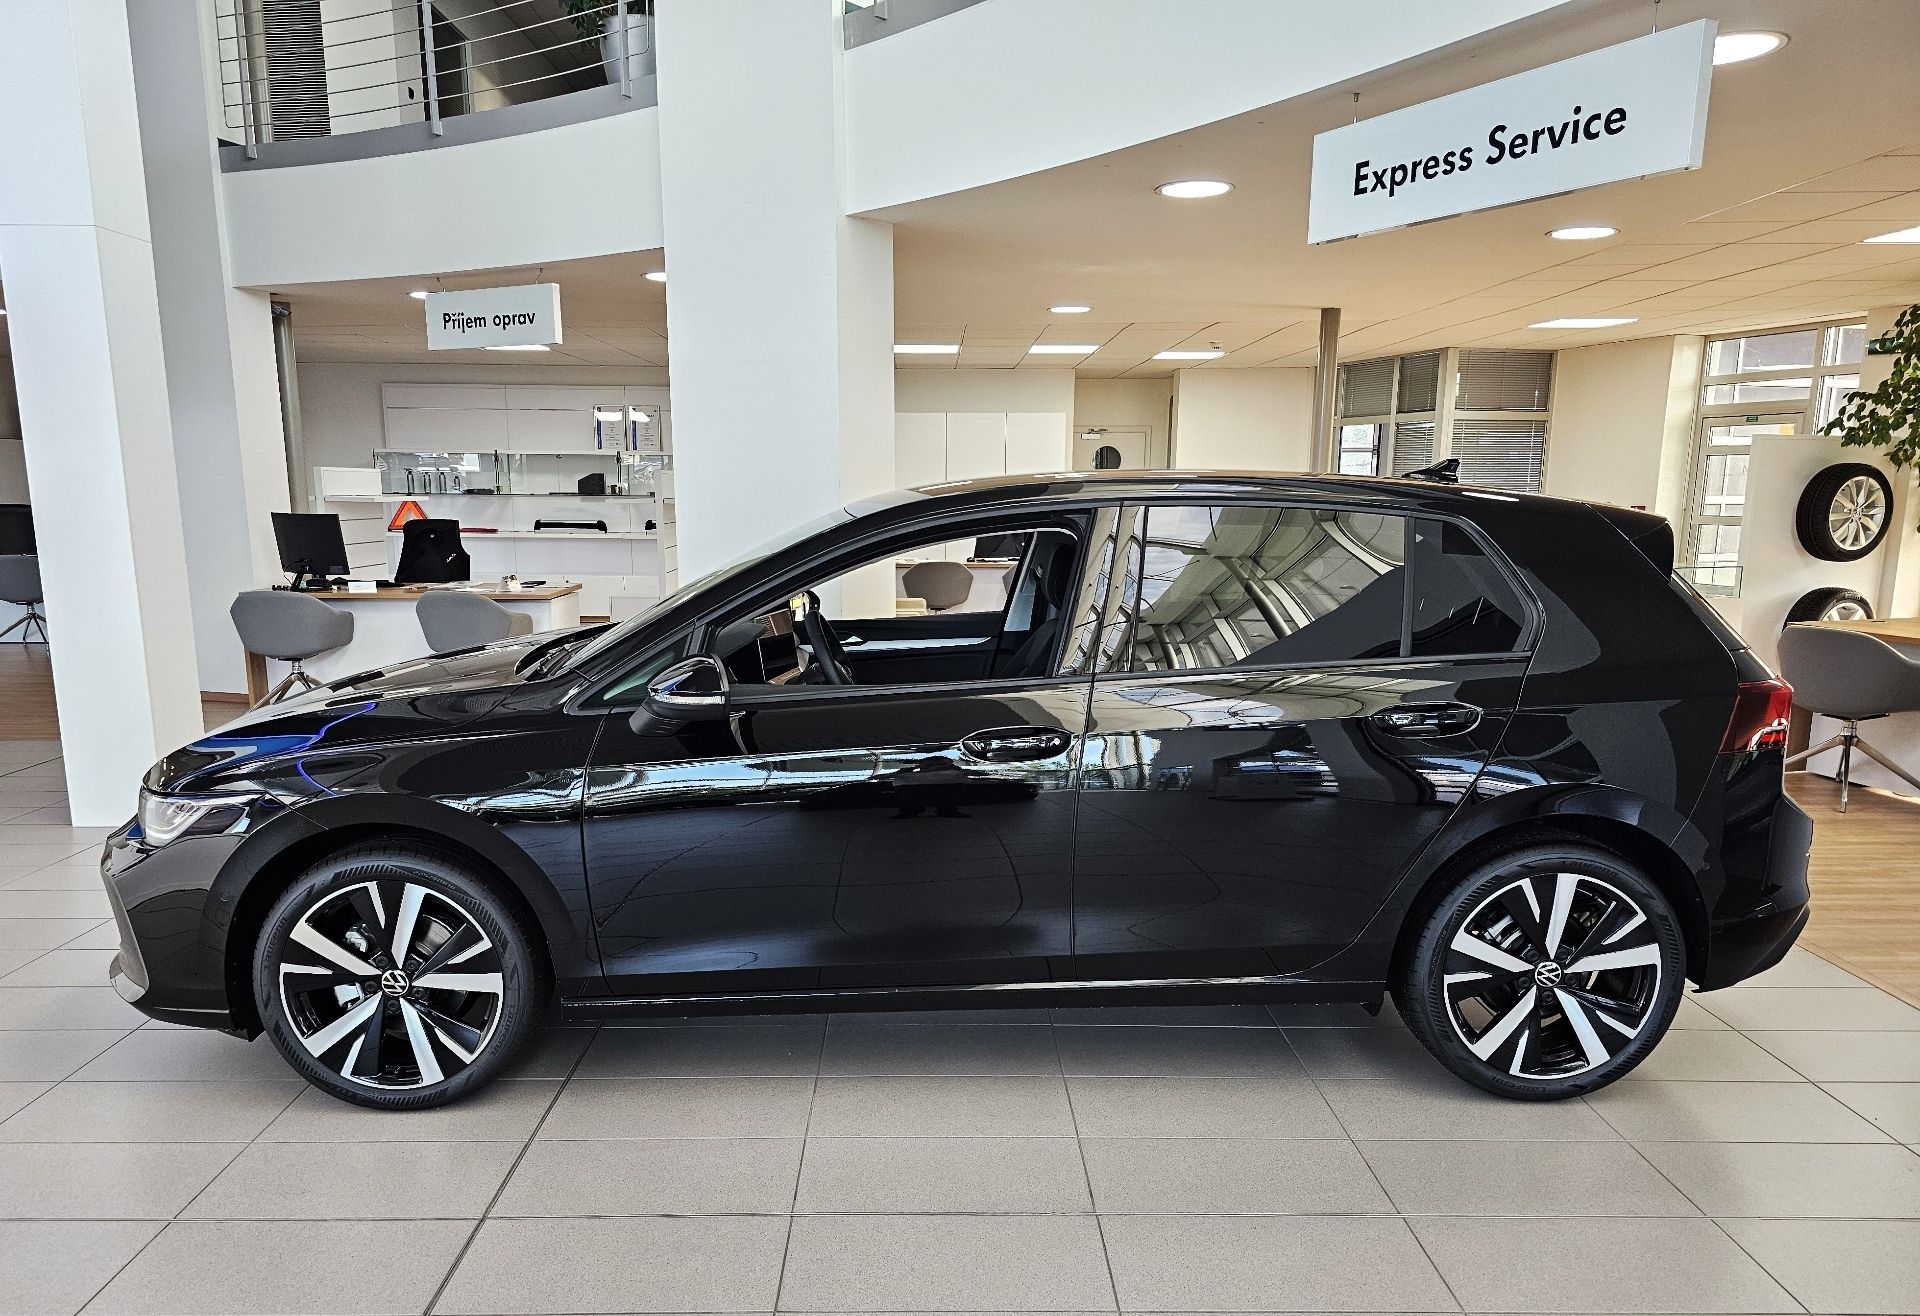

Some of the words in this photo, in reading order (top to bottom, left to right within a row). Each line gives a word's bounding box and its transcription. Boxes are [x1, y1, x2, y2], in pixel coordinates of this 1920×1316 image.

[1353, 146, 1473, 197] Express
[1485, 105, 1627, 165] Service
[442, 311, 487, 333] Příjem
[492, 312, 536, 330] oprav
